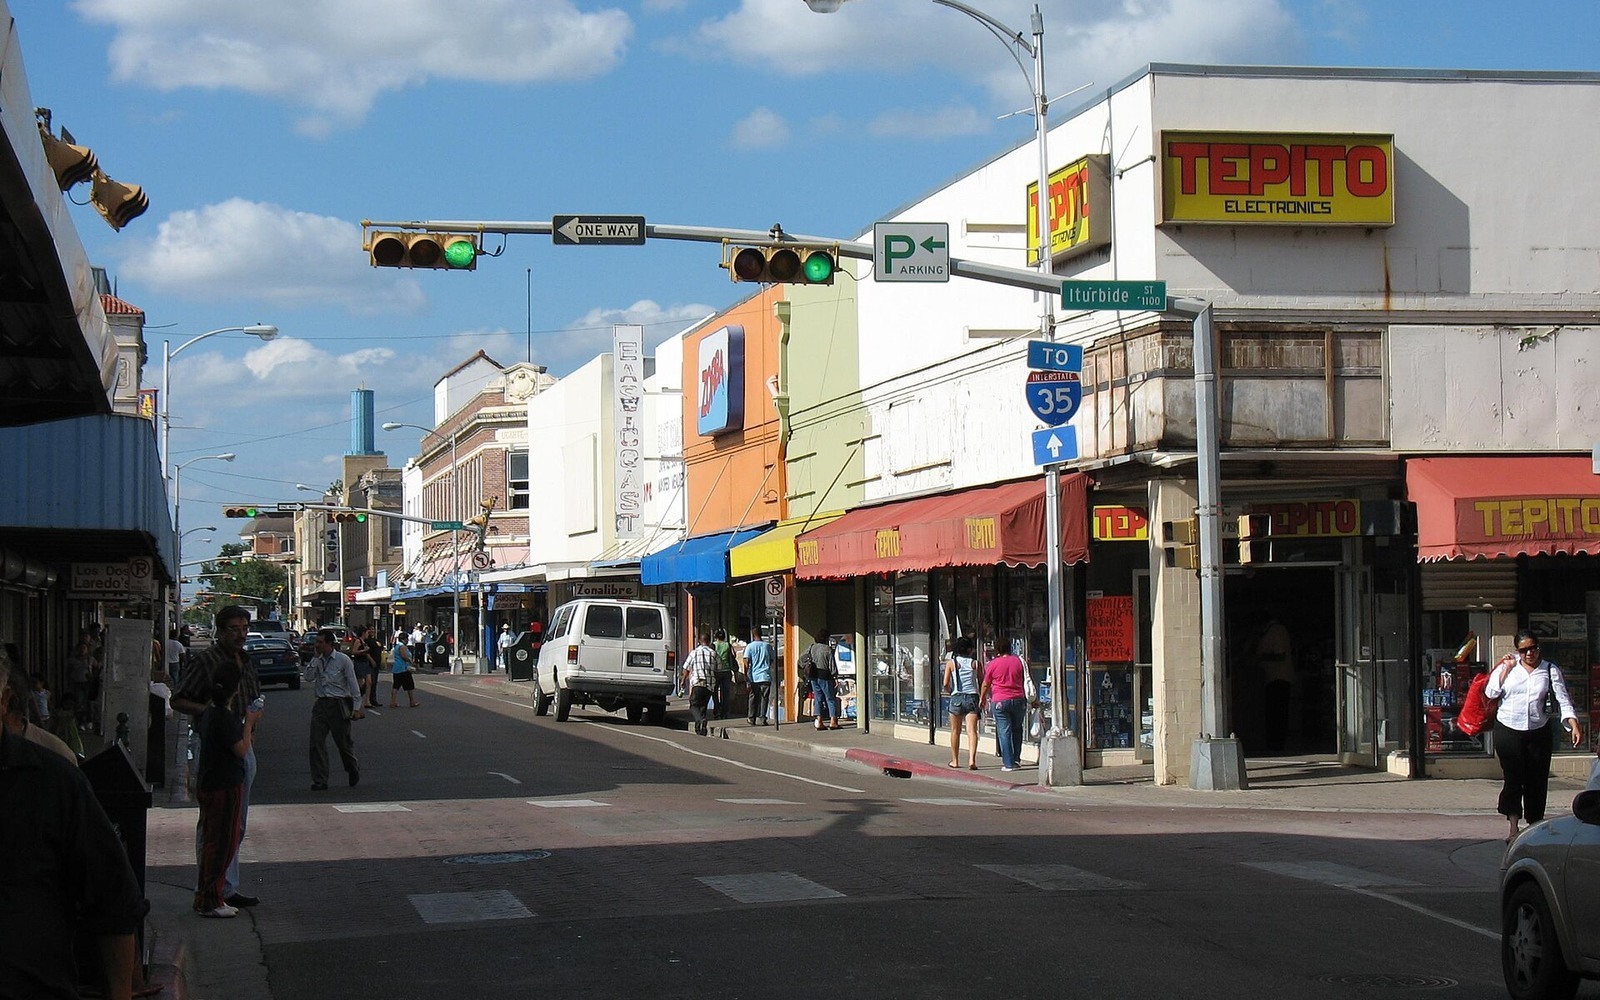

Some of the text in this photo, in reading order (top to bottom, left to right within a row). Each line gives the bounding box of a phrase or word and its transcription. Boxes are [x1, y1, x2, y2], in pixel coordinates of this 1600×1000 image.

[1168, 142, 1388, 198] TEPITO
[1225, 200, 1331, 214] ELECTRONICS
[575, 225, 633, 236] ONE WAY
[1069, 286, 1153, 303] Iturbide ST
[1142, 297, 1160, 306] 1100
[1042, 348, 1068, 365] TO
[1032, 373, 1073, 381] INTERSTATE
[1038, 388, 1072, 415] 35
[1474, 499, 1600, 536] TEPITO
[965, 517, 996, 549] TEPITO
[77, 566, 129, 576] Los Dos
[74, 577, 129, 589] Laredo's
[577, 584, 633, 595] Zonalibre
